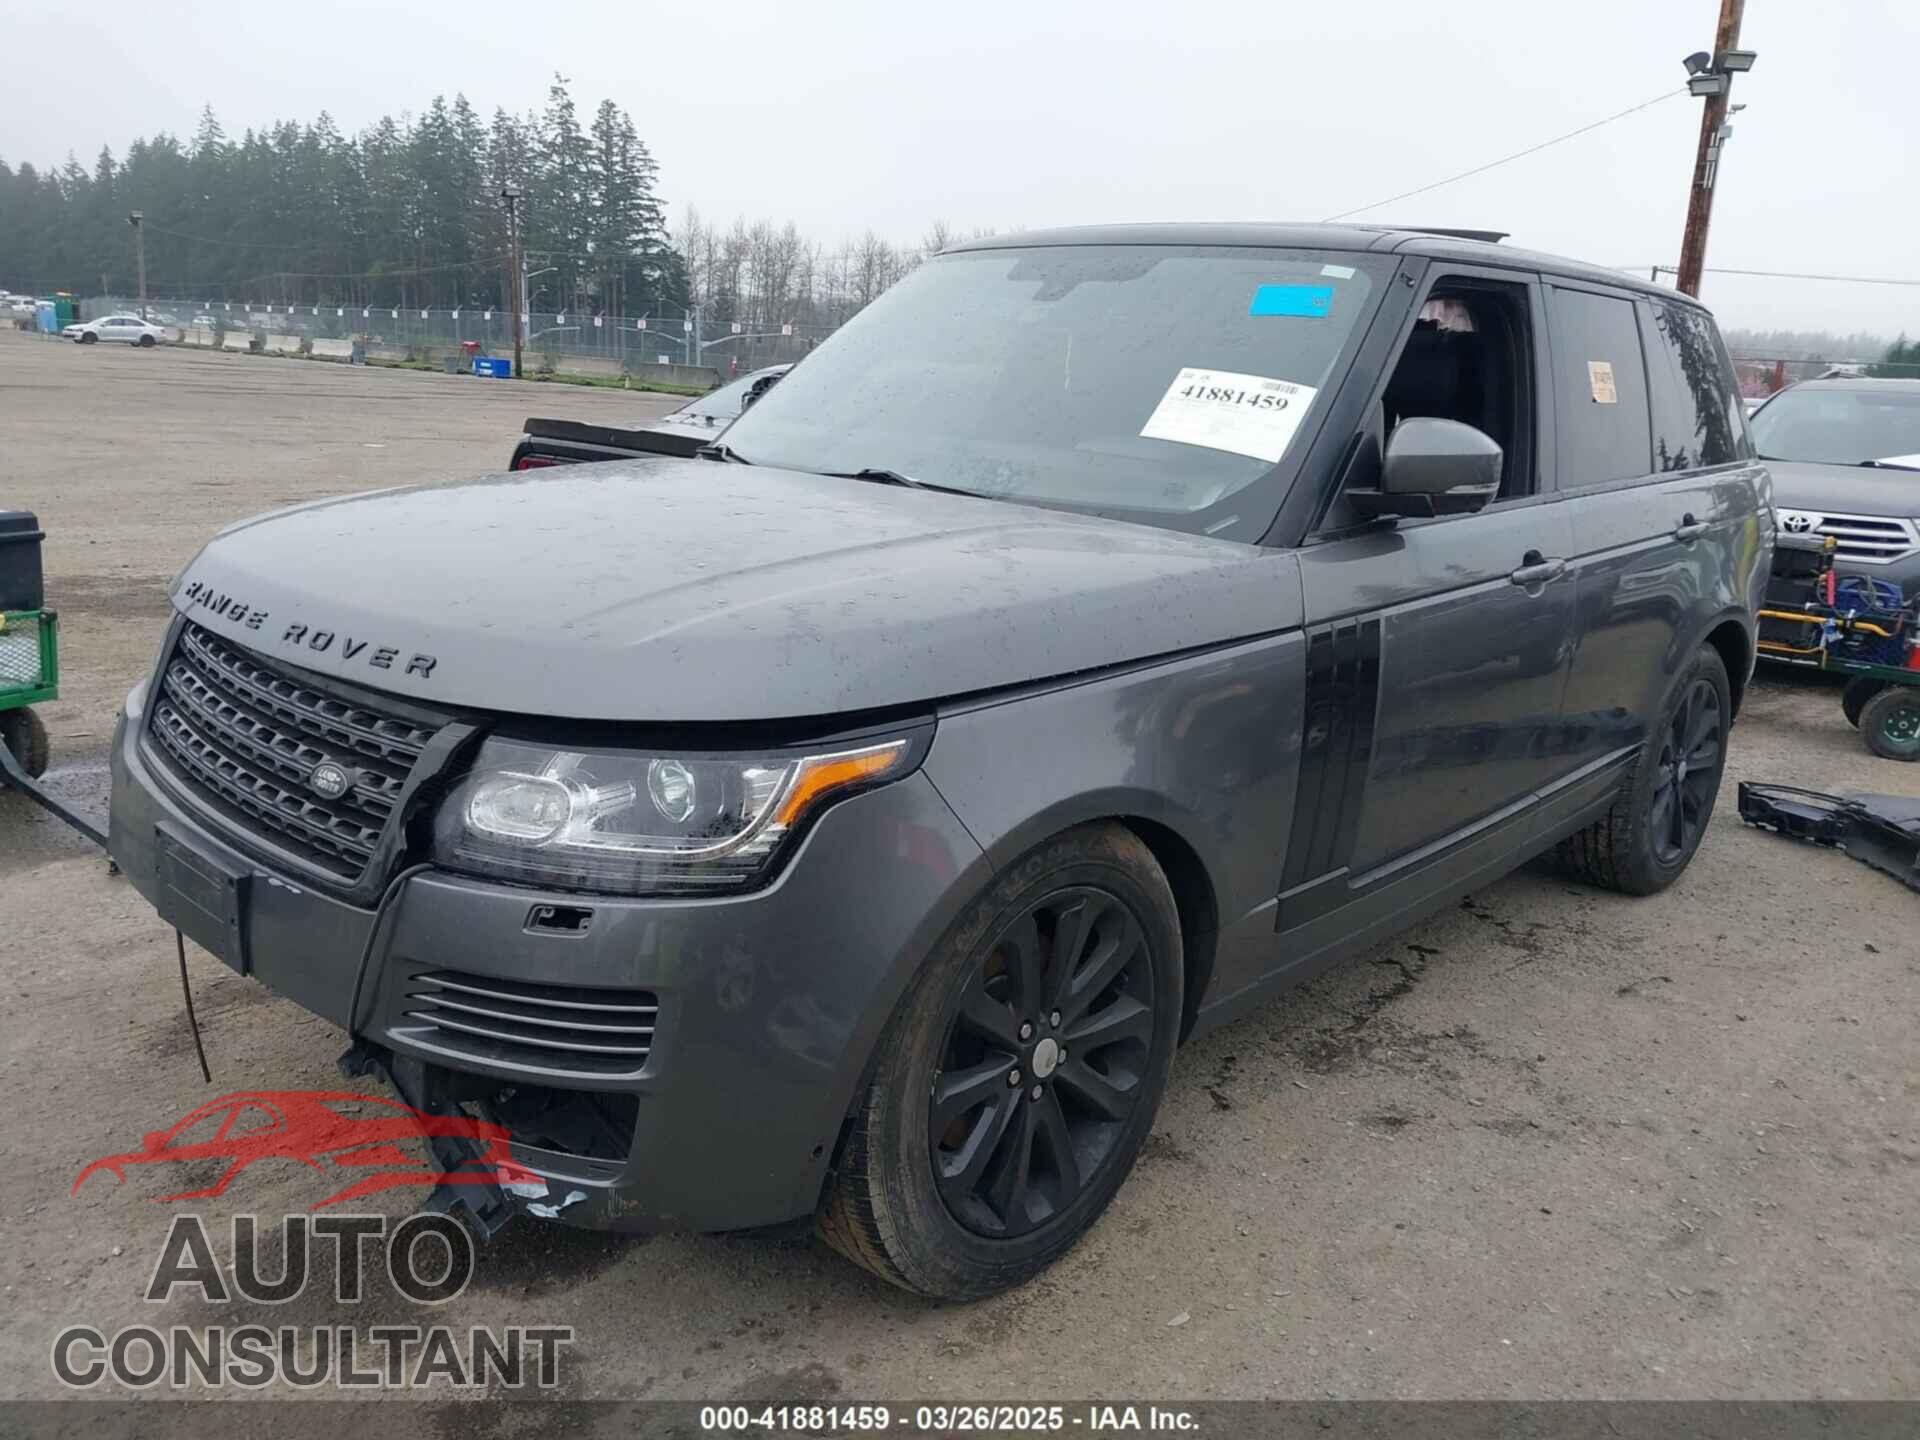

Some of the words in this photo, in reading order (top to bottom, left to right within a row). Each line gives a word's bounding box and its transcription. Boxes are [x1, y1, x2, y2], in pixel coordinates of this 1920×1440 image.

[1181, 385, 1288, 411] 41881459
[185, 582, 269, 630] RANGE
[282, 623, 437, 678] ROVER
